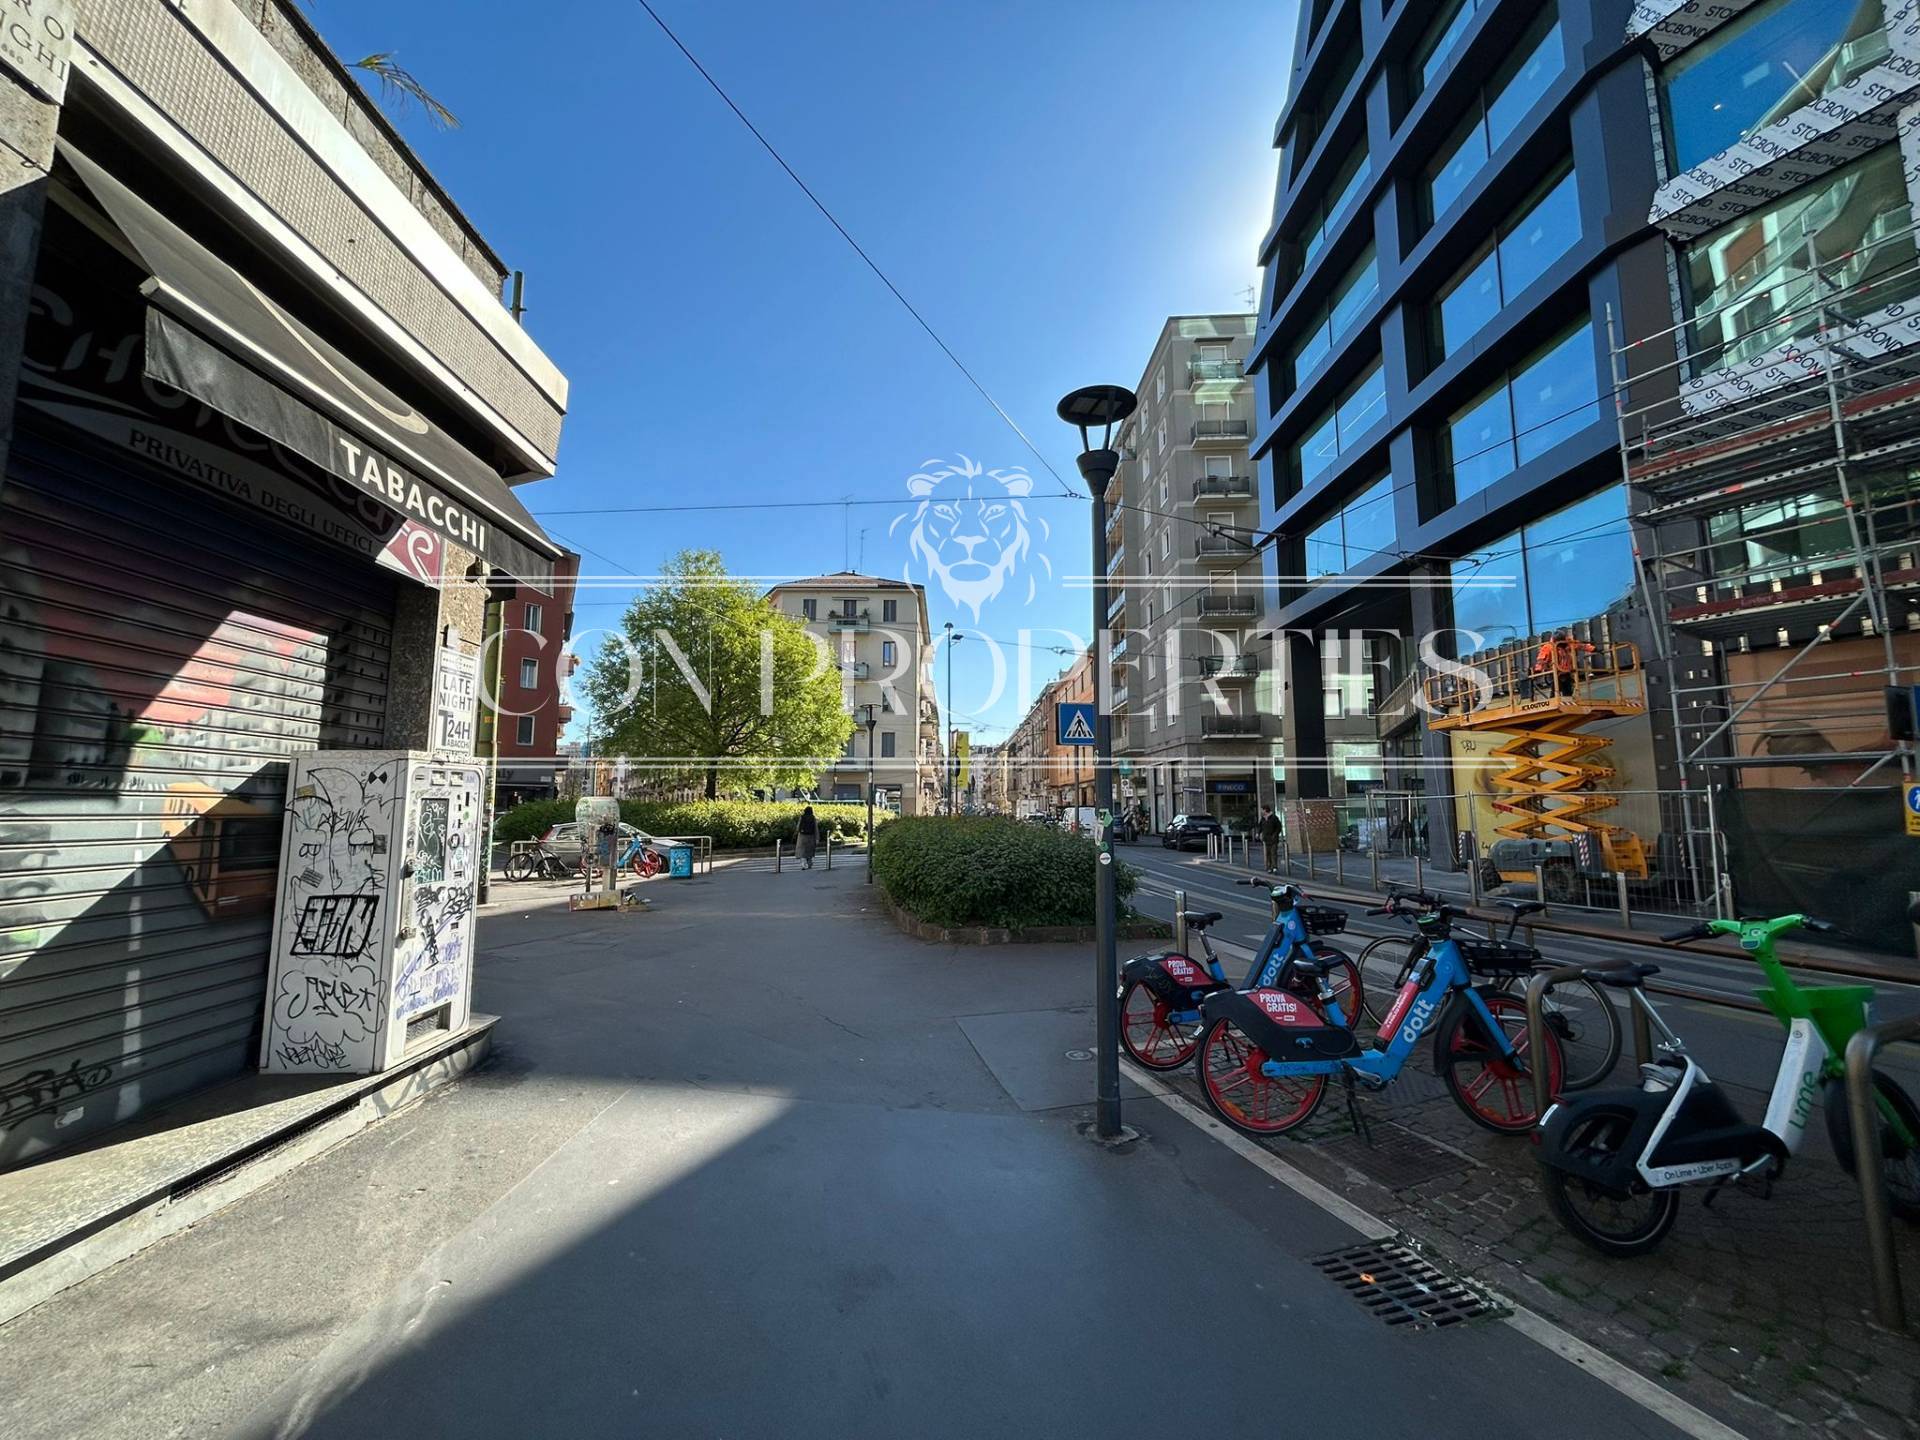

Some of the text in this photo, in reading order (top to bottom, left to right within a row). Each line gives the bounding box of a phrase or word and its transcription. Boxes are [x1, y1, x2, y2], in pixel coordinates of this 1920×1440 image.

[130, 428, 373, 553] PRIVATIVA DEGLI UFFICI
[339, 437, 485, 551] TABACCHI
[443, 674, 471, 695] LATE
[439, 692, 472, 711] NIGHT
[447, 719, 471, 740] 24H
[1263, 952, 1284, 986] dott
[1259, 993, 1286, 1003] PROVA
[1266, 1003, 1297, 1013] GRATIS!
[1403, 999, 1435, 1043] dott
[1789, 1070, 1819, 1130] Lime
[1675, 1168, 1692, 1178] Lime
